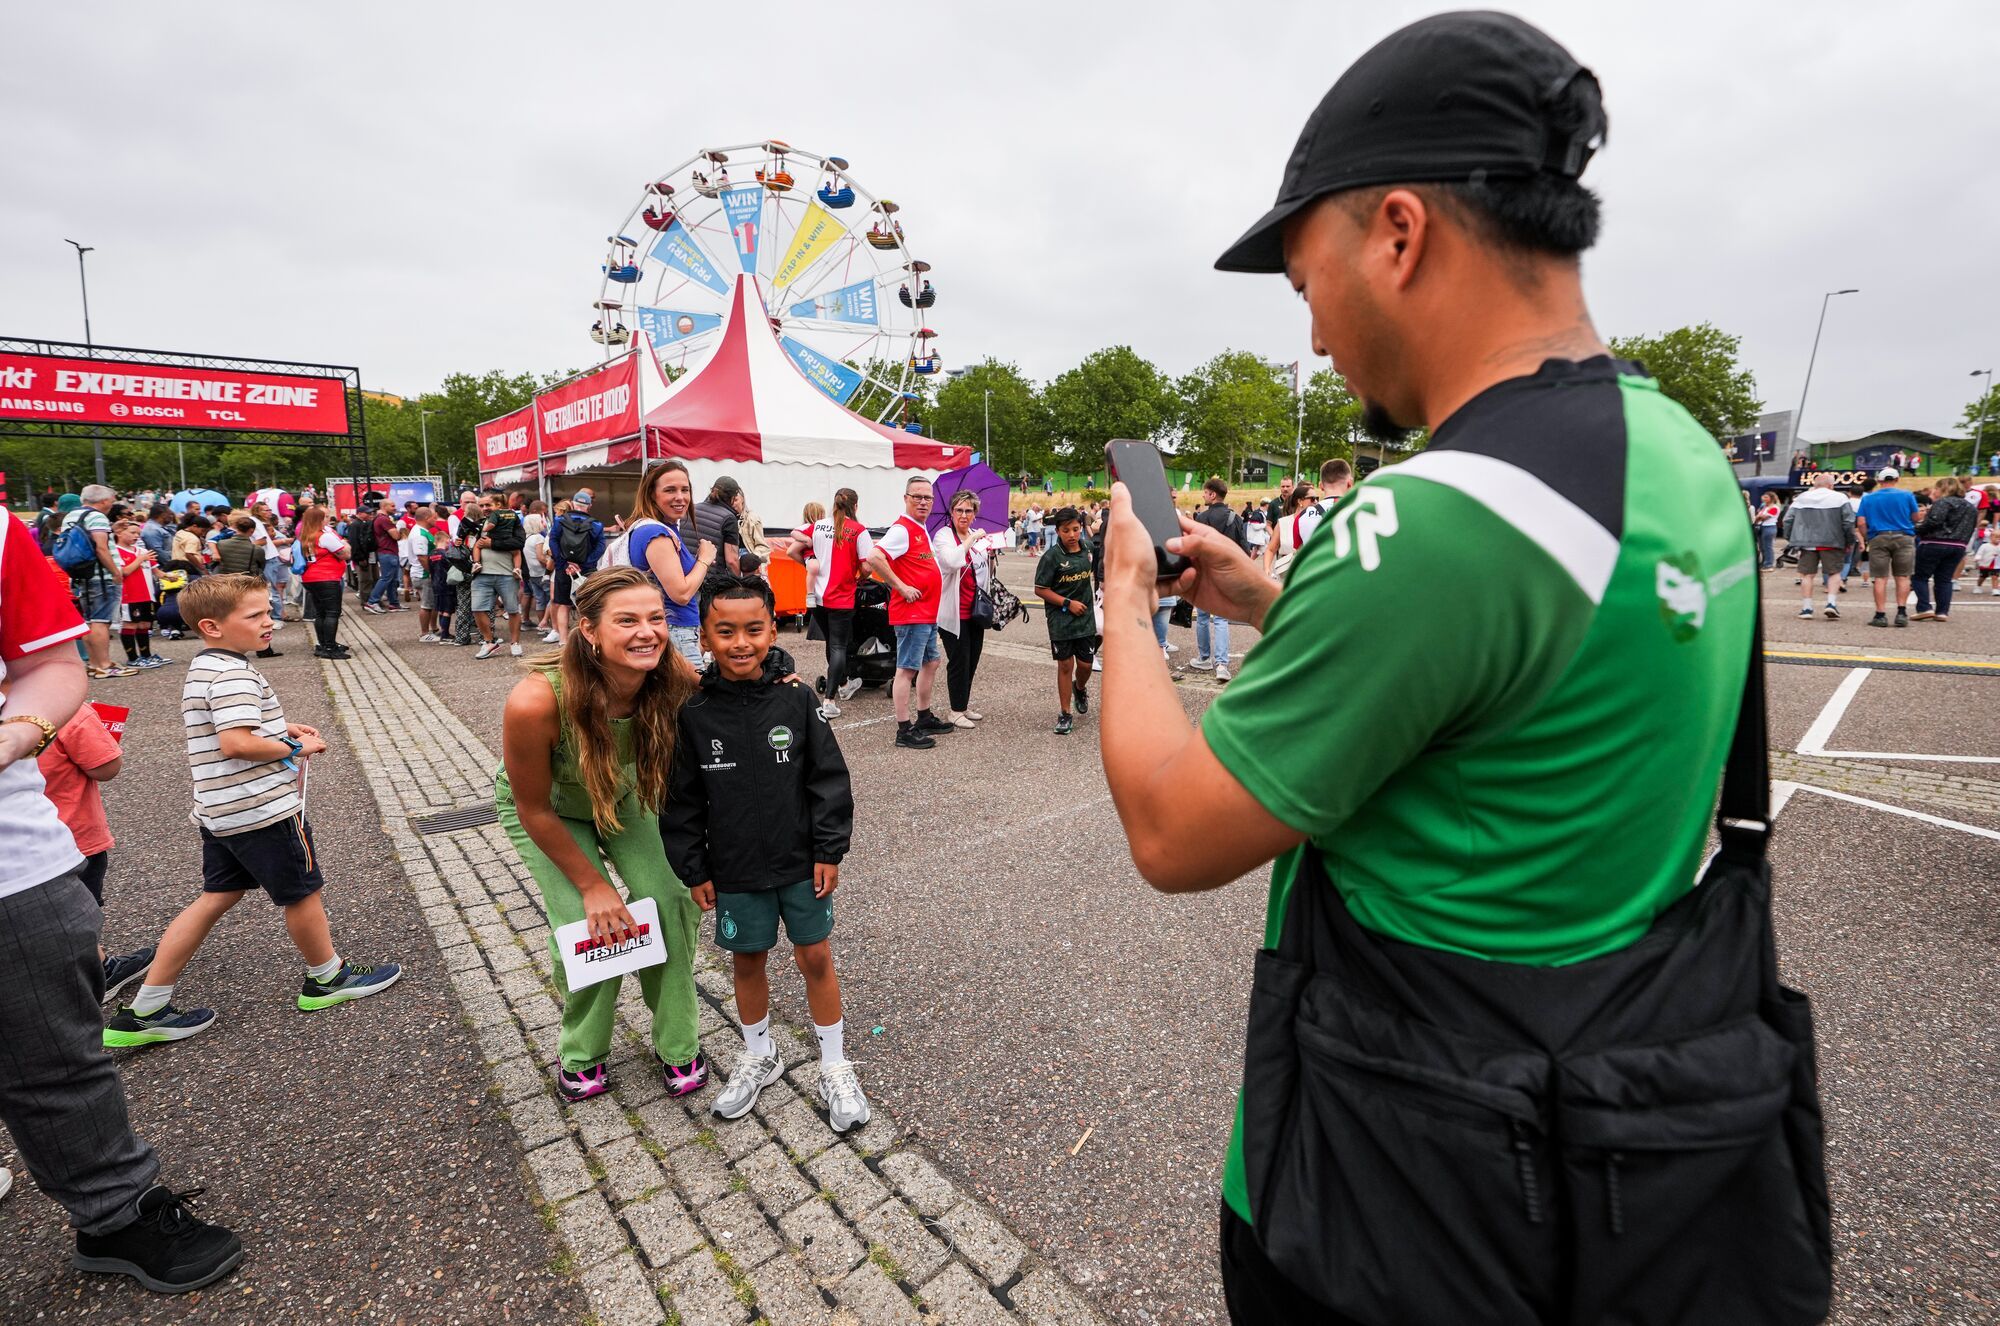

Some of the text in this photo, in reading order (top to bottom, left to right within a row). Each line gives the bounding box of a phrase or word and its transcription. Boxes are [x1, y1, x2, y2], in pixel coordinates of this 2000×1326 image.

[726, 192, 757, 208] WIN
[780, 259, 797, 281] STAP
[795, 248, 806, 260] IN
[808, 220, 826, 241] WIN!
[858, 285, 874, 319] WIN
[0, 366, 318, 407] rkt EXPERIENCE ZONE
[0, 398, 246, 421] AMSUNG BOSCH TCL
[543, 383, 630, 434] VOETBALLEN TE KOOP
[1799, 471, 1868, 486] HODOG
[776, 750, 790, 764] LK
[585, 937, 643, 962] FESTIVAL
